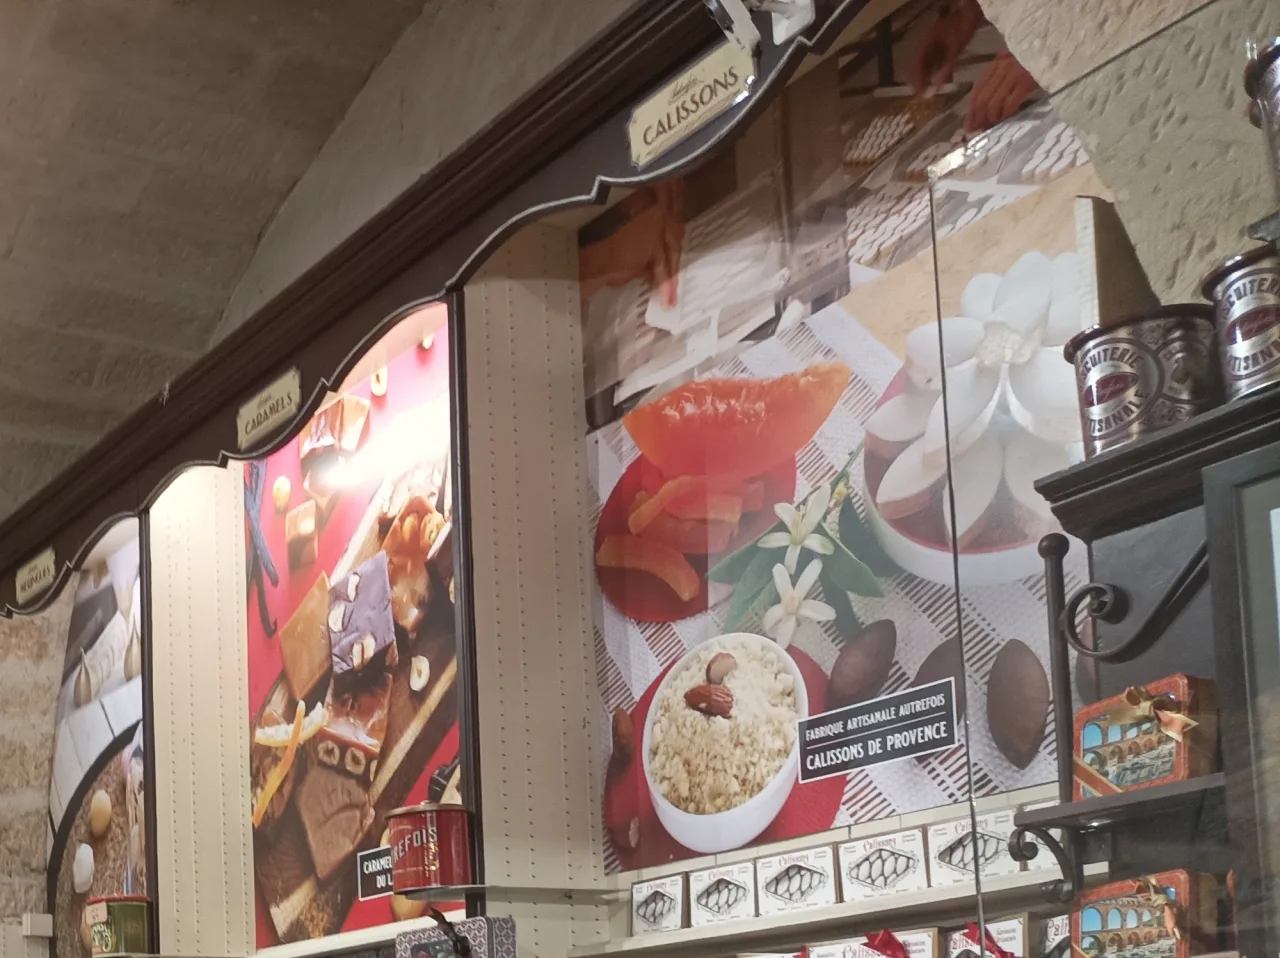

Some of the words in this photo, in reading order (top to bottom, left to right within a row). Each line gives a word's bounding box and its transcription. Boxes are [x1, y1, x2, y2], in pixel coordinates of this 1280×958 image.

[642, 65, 739, 146] CALISSONS
[244, 391, 293, 436] CARAMELS
[805, 720, 845, 742] FABRIQUE
[846, 706, 897, 731] ARTISANALE
[898, 693, 946, 718] AUTREFOIS
[806, 742, 865, 770] CALISSONS
[867, 737, 884, 757] DE
[886, 720, 948, 751] PROVENCE
[391, 826, 438, 863] REFOIS
